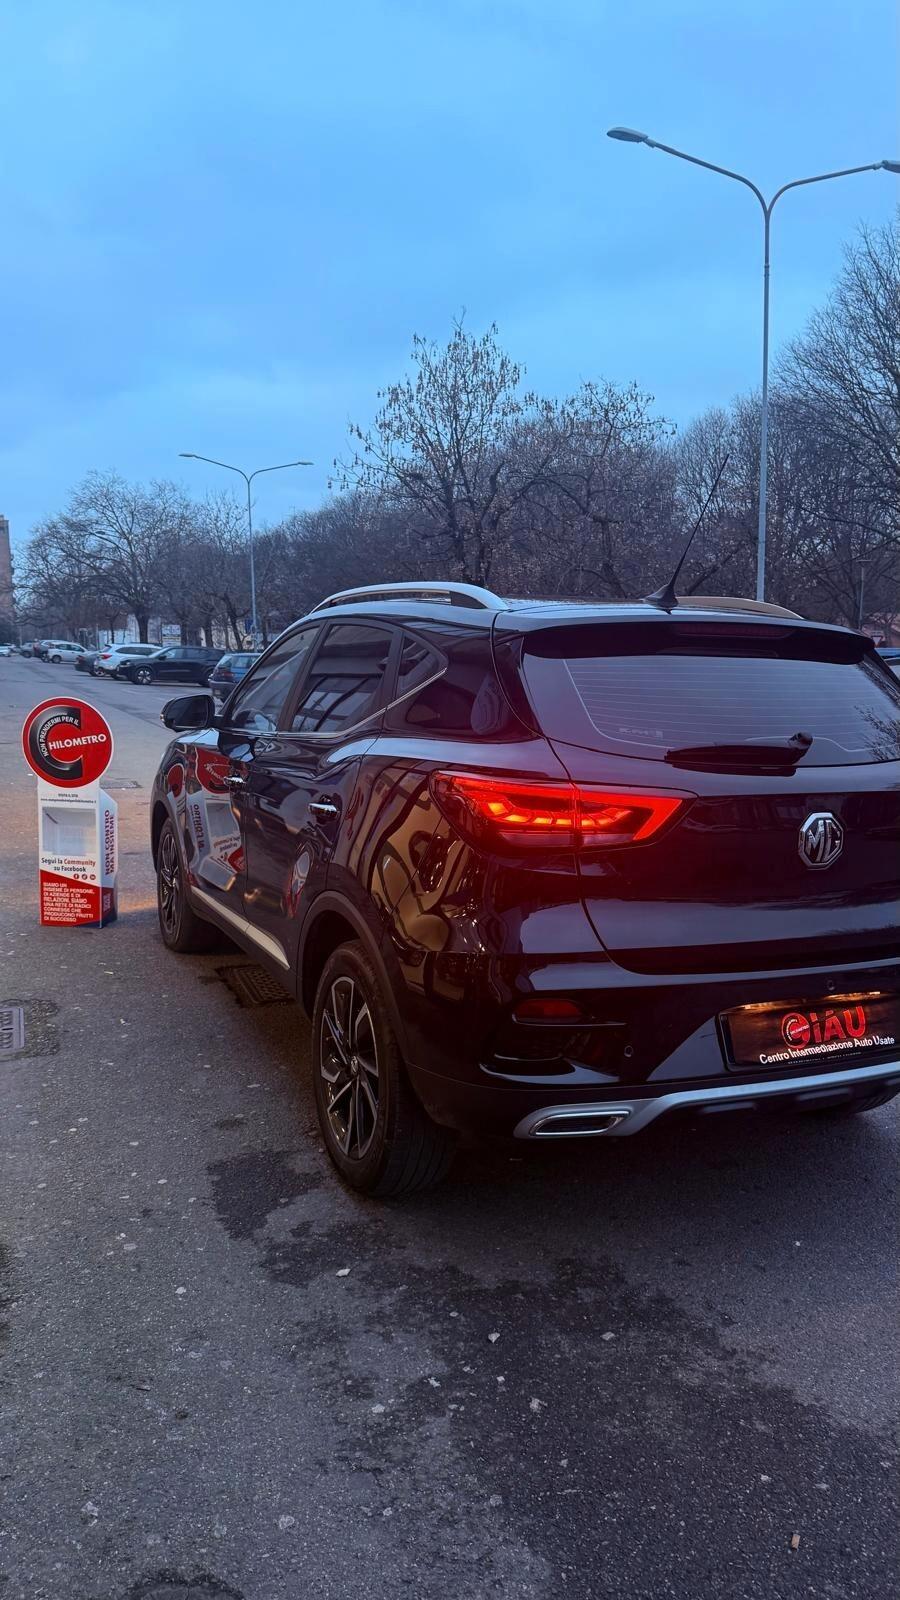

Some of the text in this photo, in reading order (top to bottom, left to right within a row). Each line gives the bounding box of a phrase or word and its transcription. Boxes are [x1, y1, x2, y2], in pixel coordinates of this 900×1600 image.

[40, 716, 80, 757] NON PRENDERMI PER IL
[41, 857, 57, 865] Segui
[64, 858, 97, 867] Community
[760, 1052, 789, 1065] Centro
[789, 1040, 853, 1058] Intermediazione
[854, 1037, 873, 1048] Auto
[873, 1035, 895, 1045] Usate
